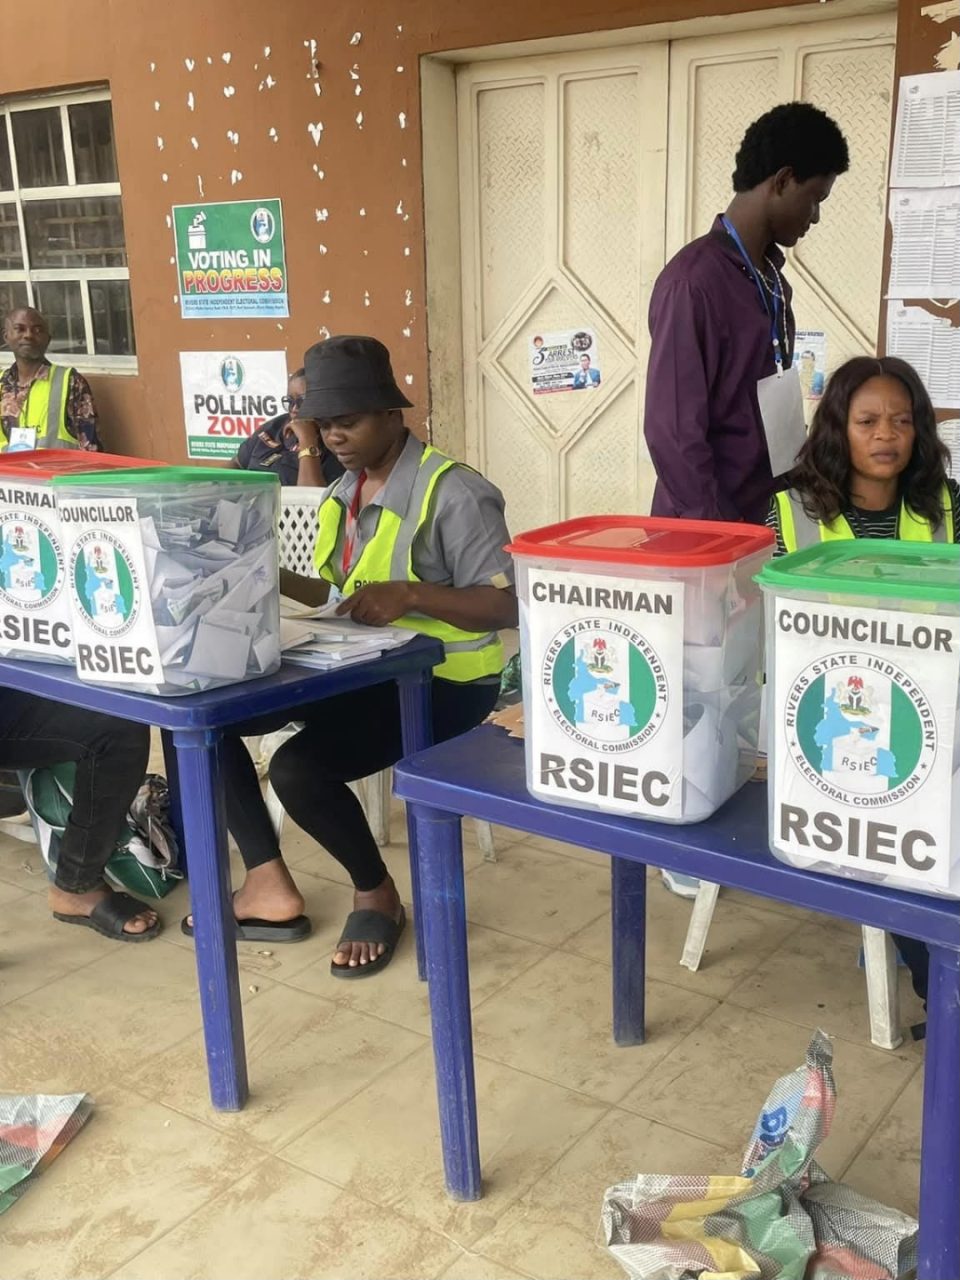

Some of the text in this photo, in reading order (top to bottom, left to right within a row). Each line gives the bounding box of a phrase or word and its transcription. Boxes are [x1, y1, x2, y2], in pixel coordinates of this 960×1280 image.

[187, 248, 271, 270] VOTING IN
[182, 267, 284, 294] PROGRESS
[194, 394, 278, 417] POLLING
[532, 581, 673, 615] CHAIRMAN
[0, 613, 72, 648] SIEC
[778, 609, 953, 653] COUNCILLOR
[78, 643, 155, 676] RSIEC
[543, 619, 667, 703] RIVERS STATE INDEPENDENT
[591, 708, 620, 722] RSIEC
[786, 655, 935, 752] RIVERS STATE INDEPENDENT
[552, 708, 657, 752] ELECTORAL COMMISSION
[540, 752, 671, 807] RSIEC
[795, 754, 922, 806] ELECTORAL COMMISSION
[841, 756, 878, 772] RSIEC
[780, 802, 937, 871] RSIEC
